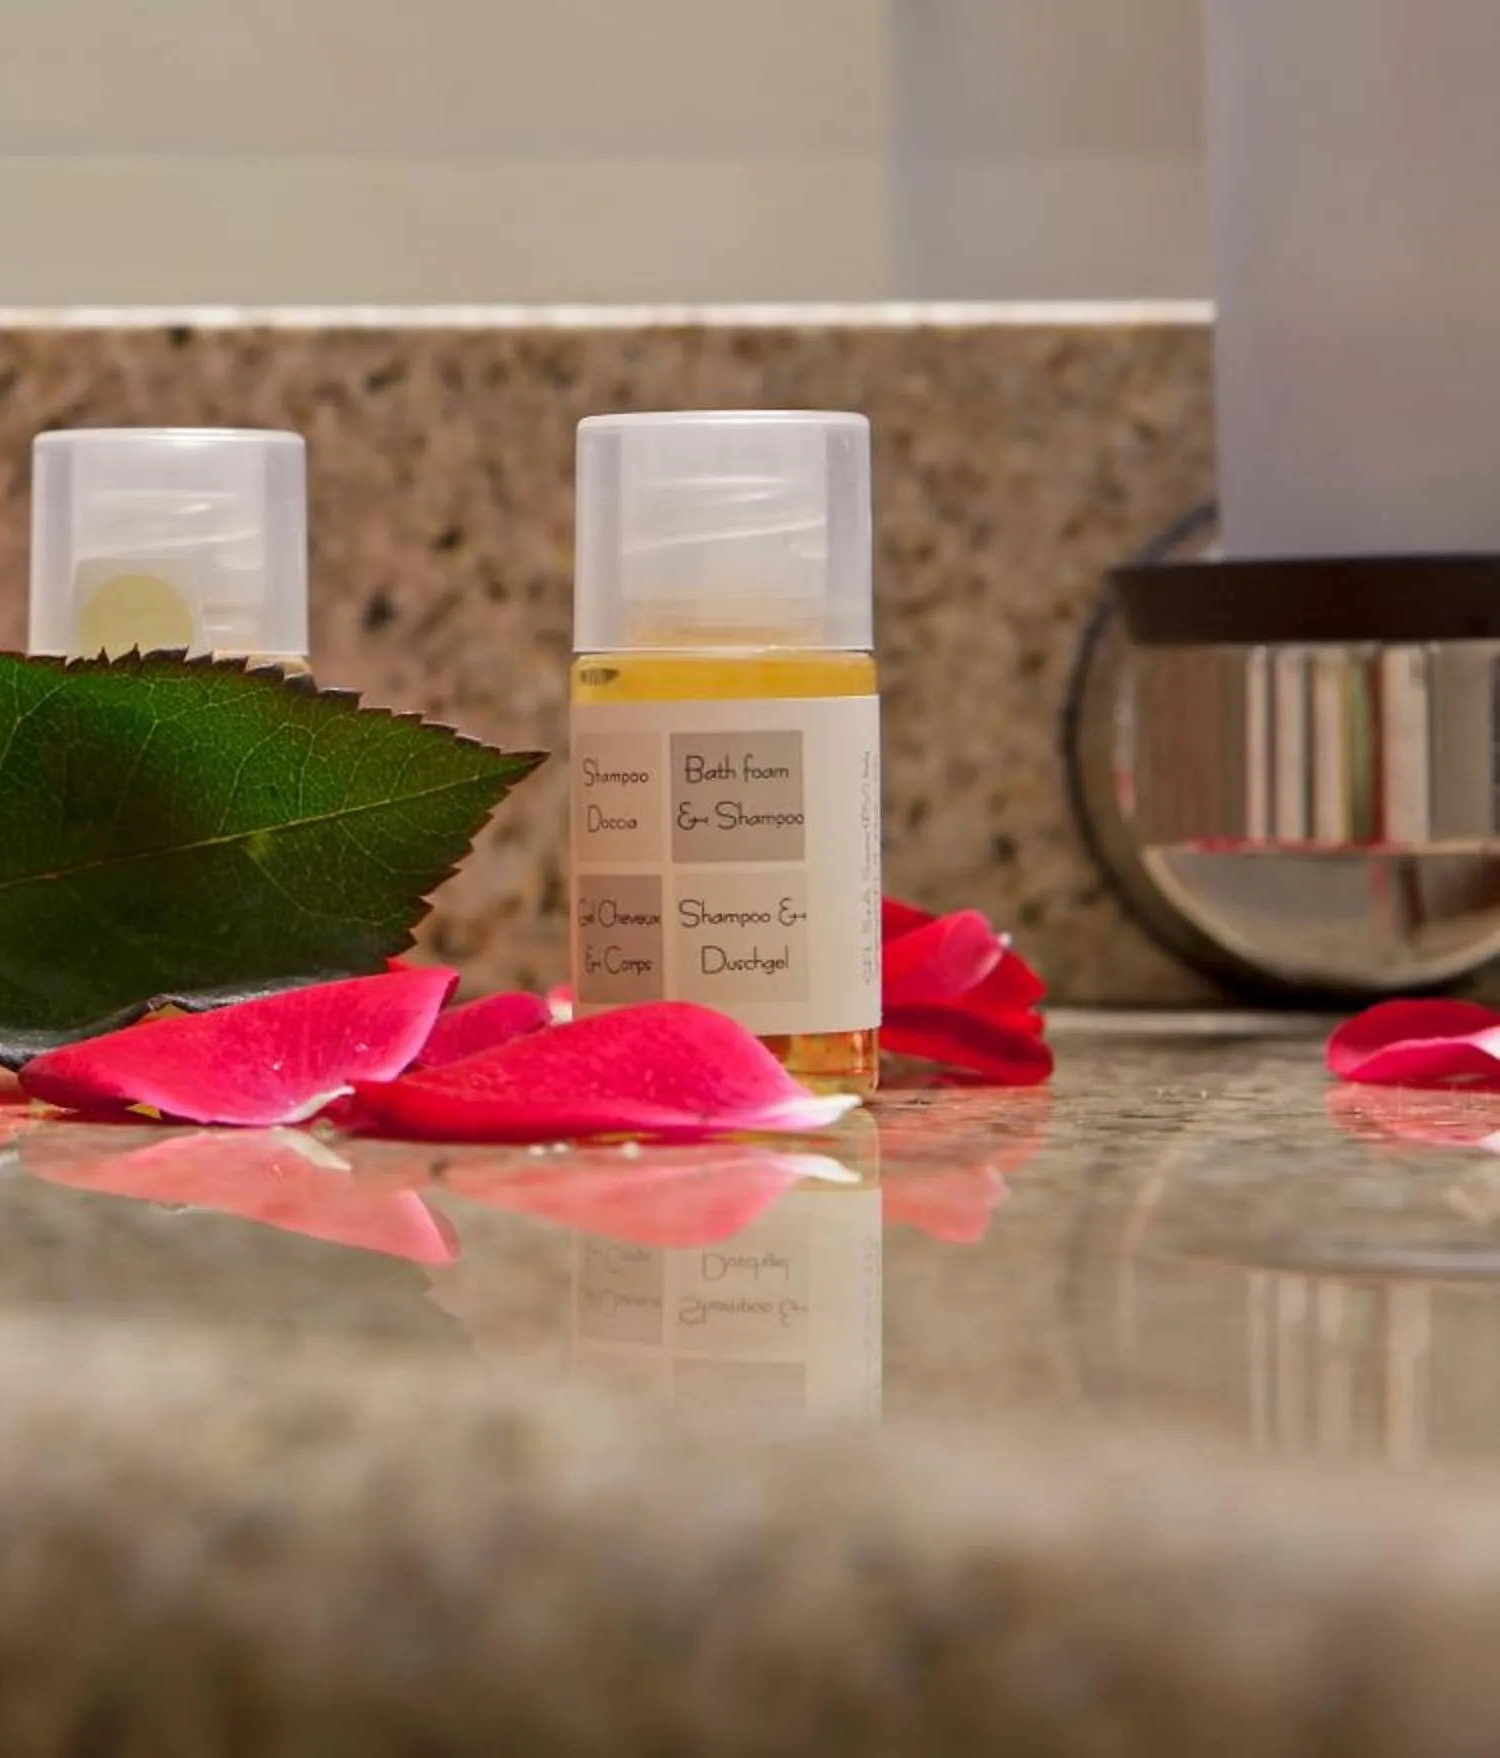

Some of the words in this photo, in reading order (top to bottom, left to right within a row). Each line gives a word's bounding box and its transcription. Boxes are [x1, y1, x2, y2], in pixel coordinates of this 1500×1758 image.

[582, 757, 649, 788] Shampoo
[684, 754, 736, 784] Bath
[742, 754, 790, 782] foam
[587, 804, 638, 833] Doccia
[676, 801, 709, 831] &
[714, 801, 805, 831] Shampoo
[598, 898, 662, 929] Cheveux
[678, 899, 772, 929] Shampoo
[777, 897, 808, 928] &
[603, 945, 654, 976] Corps
[700, 945, 790, 976] Duschgel
